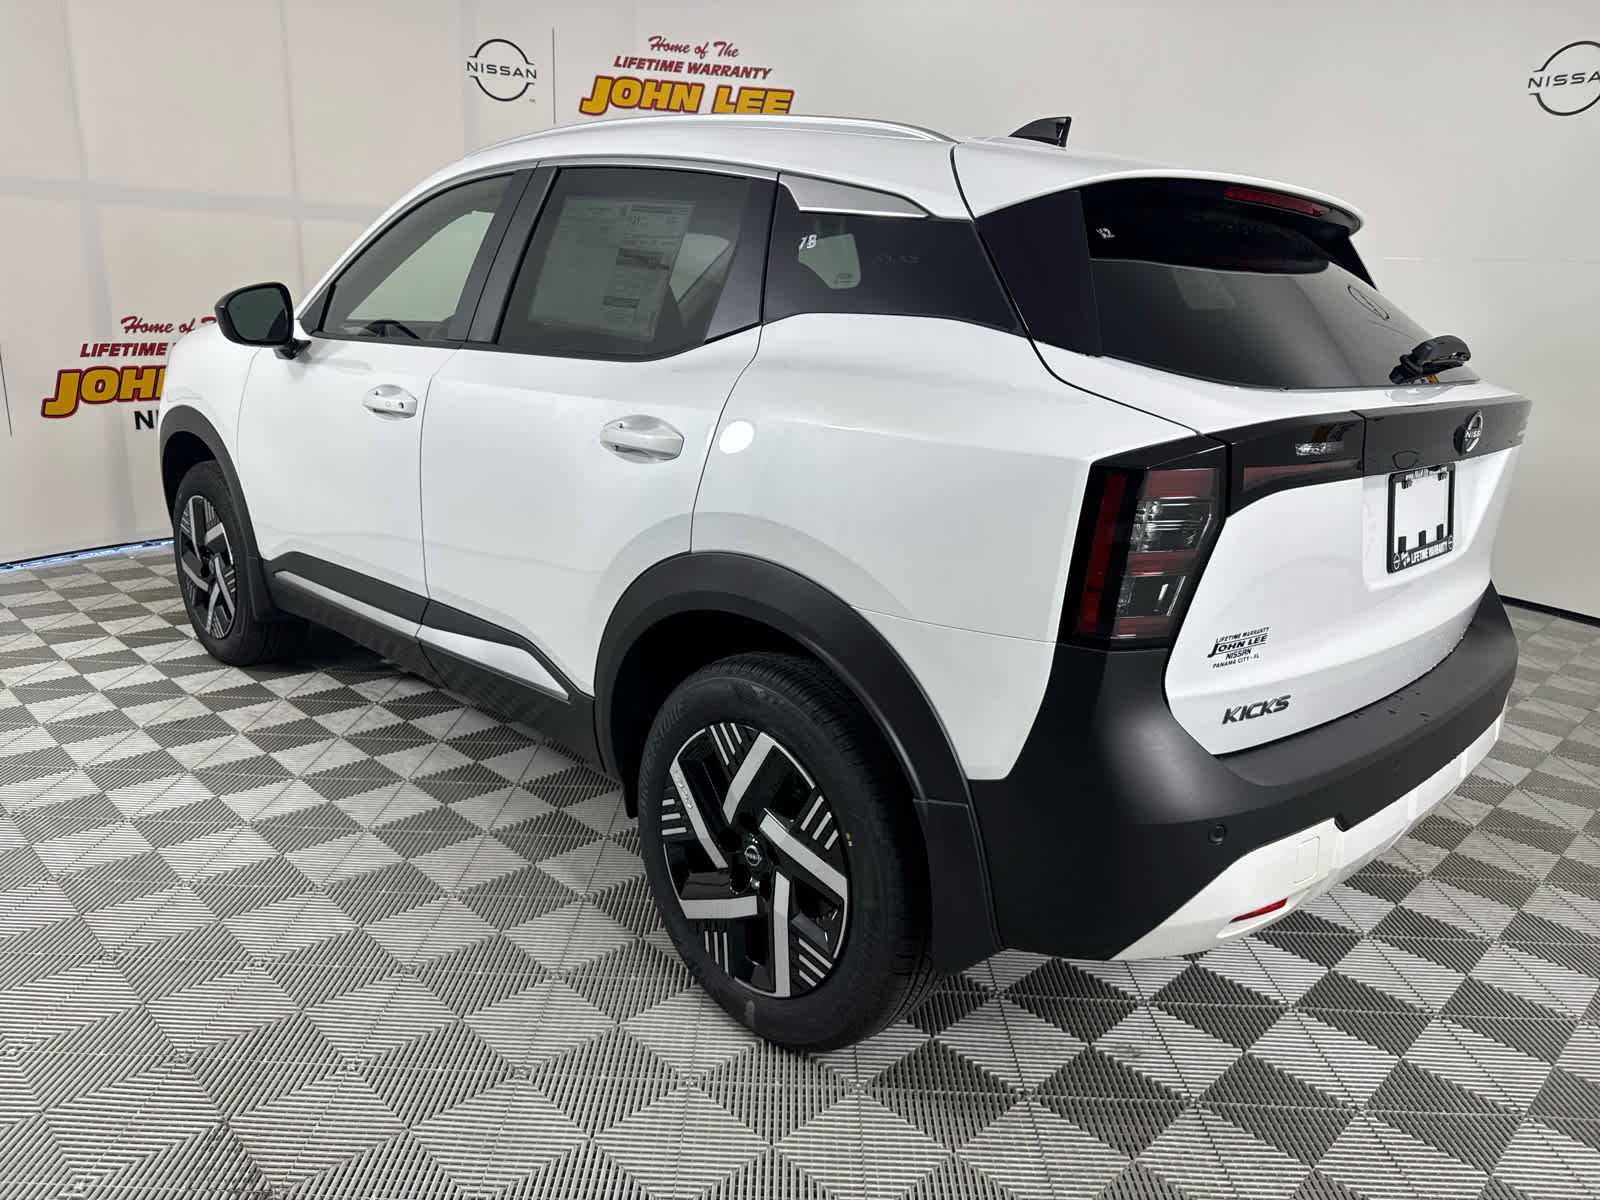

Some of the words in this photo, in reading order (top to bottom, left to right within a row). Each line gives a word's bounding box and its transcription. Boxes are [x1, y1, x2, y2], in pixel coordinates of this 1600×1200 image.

[648, 35, 690, 54] Home
[694, 41, 709, 59] of
[713, 41, 740, 58] The
[466, 61, 537, 79] NISSAN
[613, 55, 684, 73] LIFETIME
[687, 62, 772, 80] WARRANTY
[1527, 71, 1600, 89] NISSA
[579, 75, 705, 116] JOHN
[711, 85, 794, 114] LEE
[120, 315, 174, 333] Home
[79, 342, 169, 358] LIFETIME
[1207, 640, 1246, 658] JOHN
[1247, 635, 1268, 646] LEE
[1215, 633, 1241, 644] LIFETIME
[1212, 660, 1237, 669] PANAMA
[1237, 656, 1249, 664] CITY
[1225, 648, 1252, 660] NISSAN
[1221, 694, 1292, 725] KICKS
